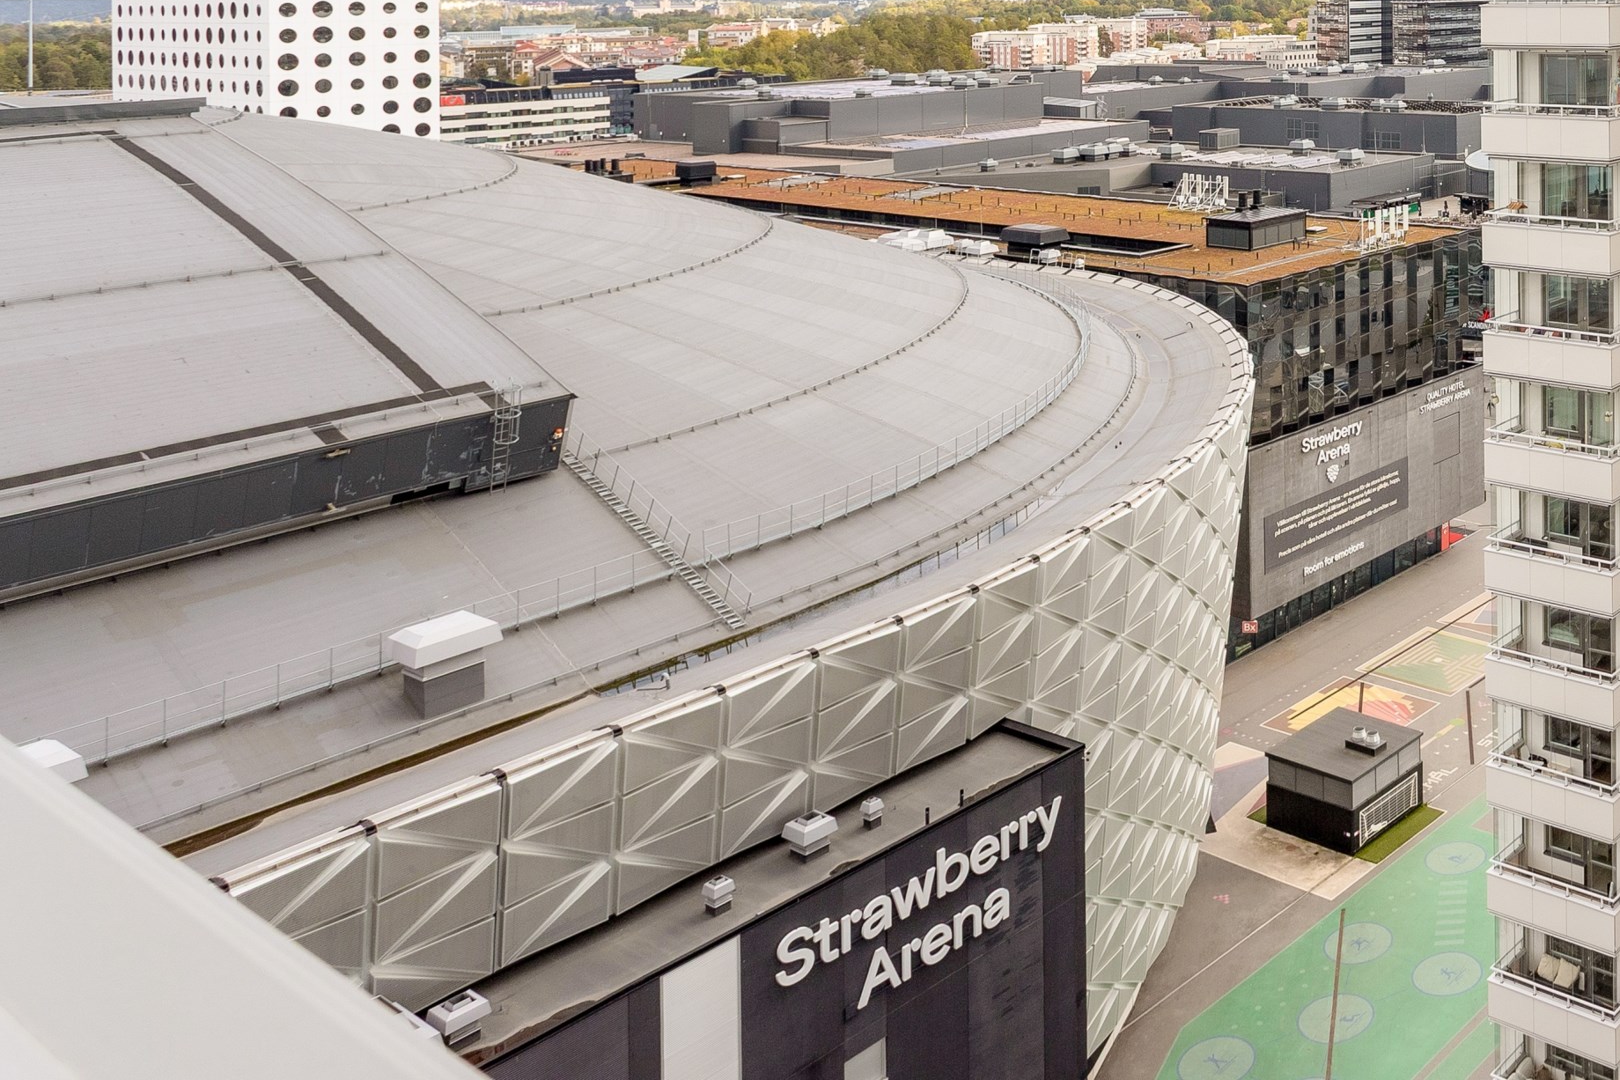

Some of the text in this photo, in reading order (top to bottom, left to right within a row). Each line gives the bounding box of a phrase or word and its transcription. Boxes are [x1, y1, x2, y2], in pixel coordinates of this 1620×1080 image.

[1427, 380, 1465, 402] QUALITY HOTEL
[1453, 388, 1471, 401] ARENA
[1301, 420, 1363, 453] Strawberry
[1317, 443, 1351, 466] Arena
[1303, 541, 1365, 577] Room for emotions
[774, 795, 1063, 988] Strawberry
[856, 886, 1011, 1011] Arena
